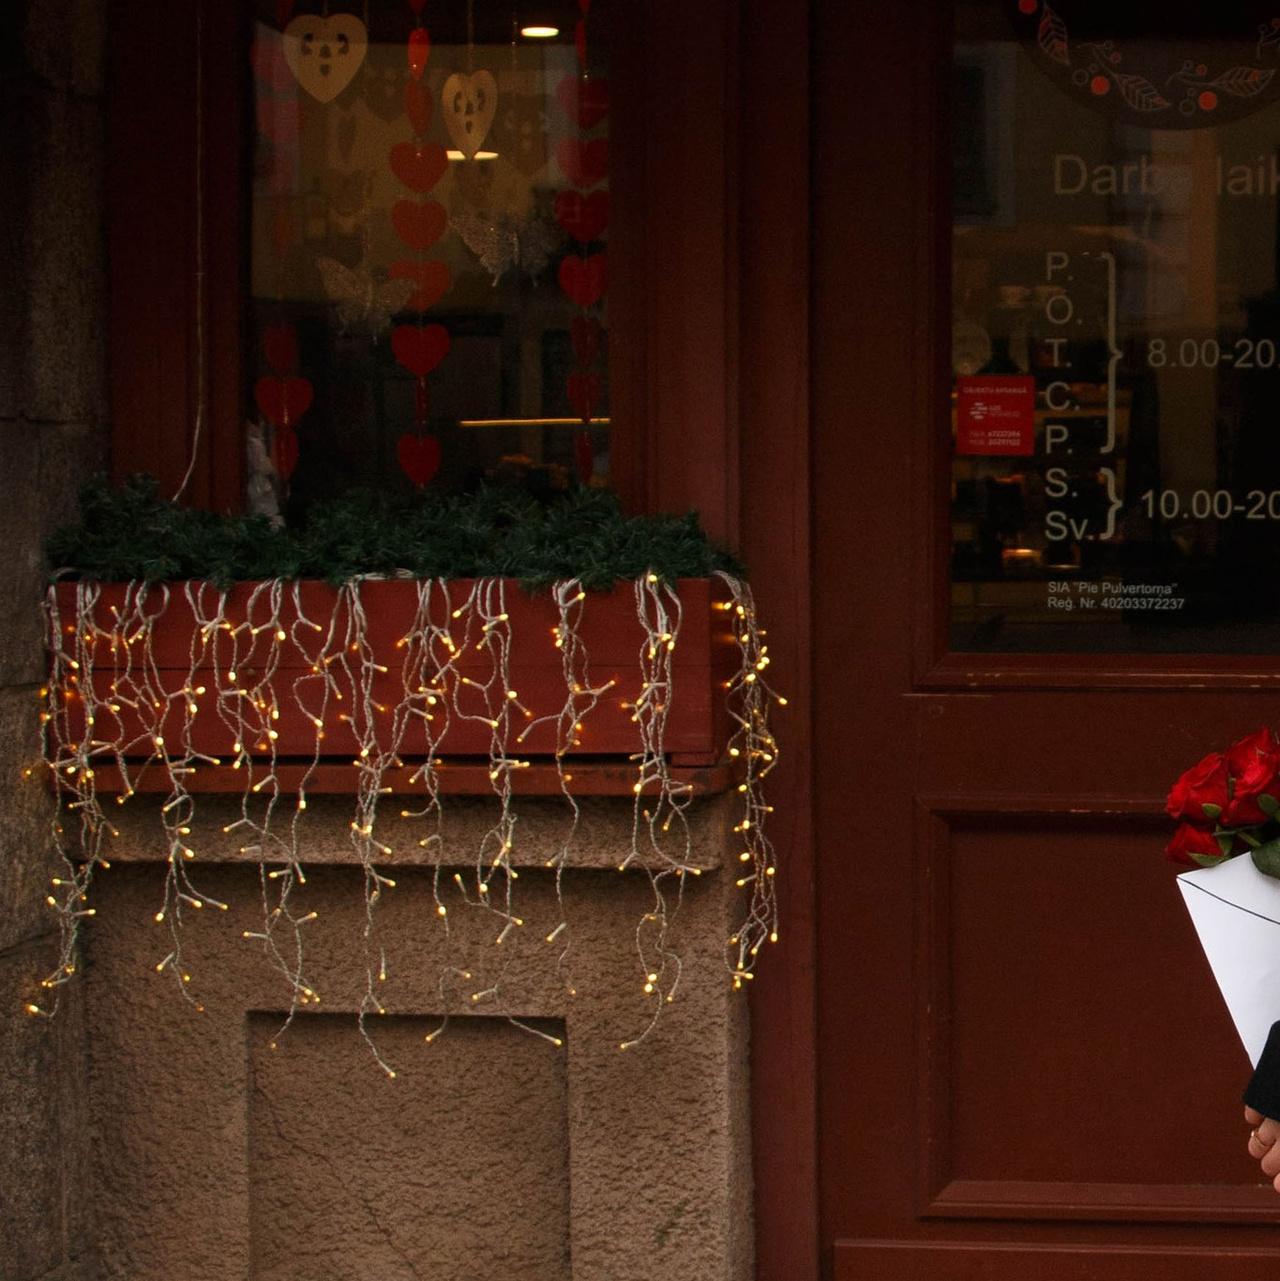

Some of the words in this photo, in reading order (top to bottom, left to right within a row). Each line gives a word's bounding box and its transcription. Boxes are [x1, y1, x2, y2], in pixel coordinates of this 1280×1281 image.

[1053, 154, 1193, 196] Darb
[1045, 252, 1075, 281] P.
[1045, 296, 1083, 325] O.
[1046, 338, 1073, 368] T.
[1045, 381, 1081, 412] C.
[1045, 424, 1074, 454] P.
[1045, 468, 1079, 498] S.
[1044, 510, 1095, 541] Sv.
[1048, 581, 1070, 593] SIA
[1073, 581, 1098, 593] "Pie
[1080, 597, 1098, 609] Nr.
[1101, 597, 1185, 610] 40203372237
